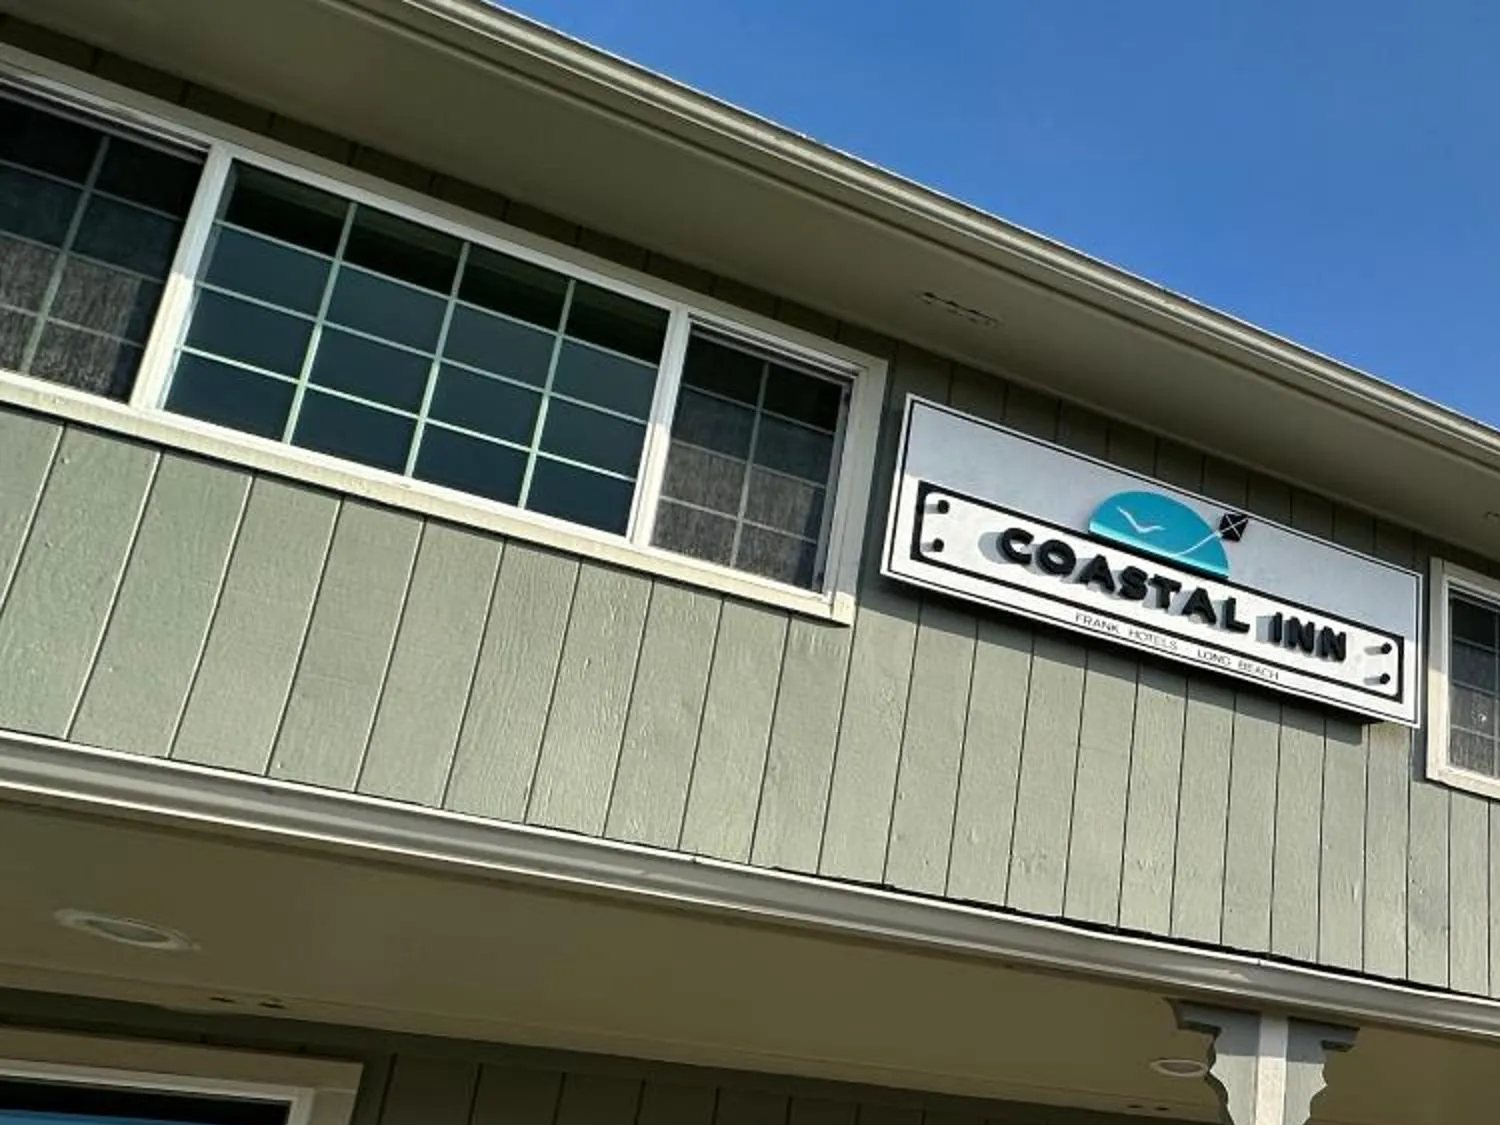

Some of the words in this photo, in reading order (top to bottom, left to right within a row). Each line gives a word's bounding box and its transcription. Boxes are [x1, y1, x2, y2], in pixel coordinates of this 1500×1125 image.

[997, 526, 1250, 633] COASTAL
[1269, 611, 1347, 662] INN
[1074, 611, 1120, 633] FRANK
[1128, 628, 1178, 651] HOTELS
[1197, 648, 1232, 667] LONG
[1237, 660, 1280, 681] BEACH
